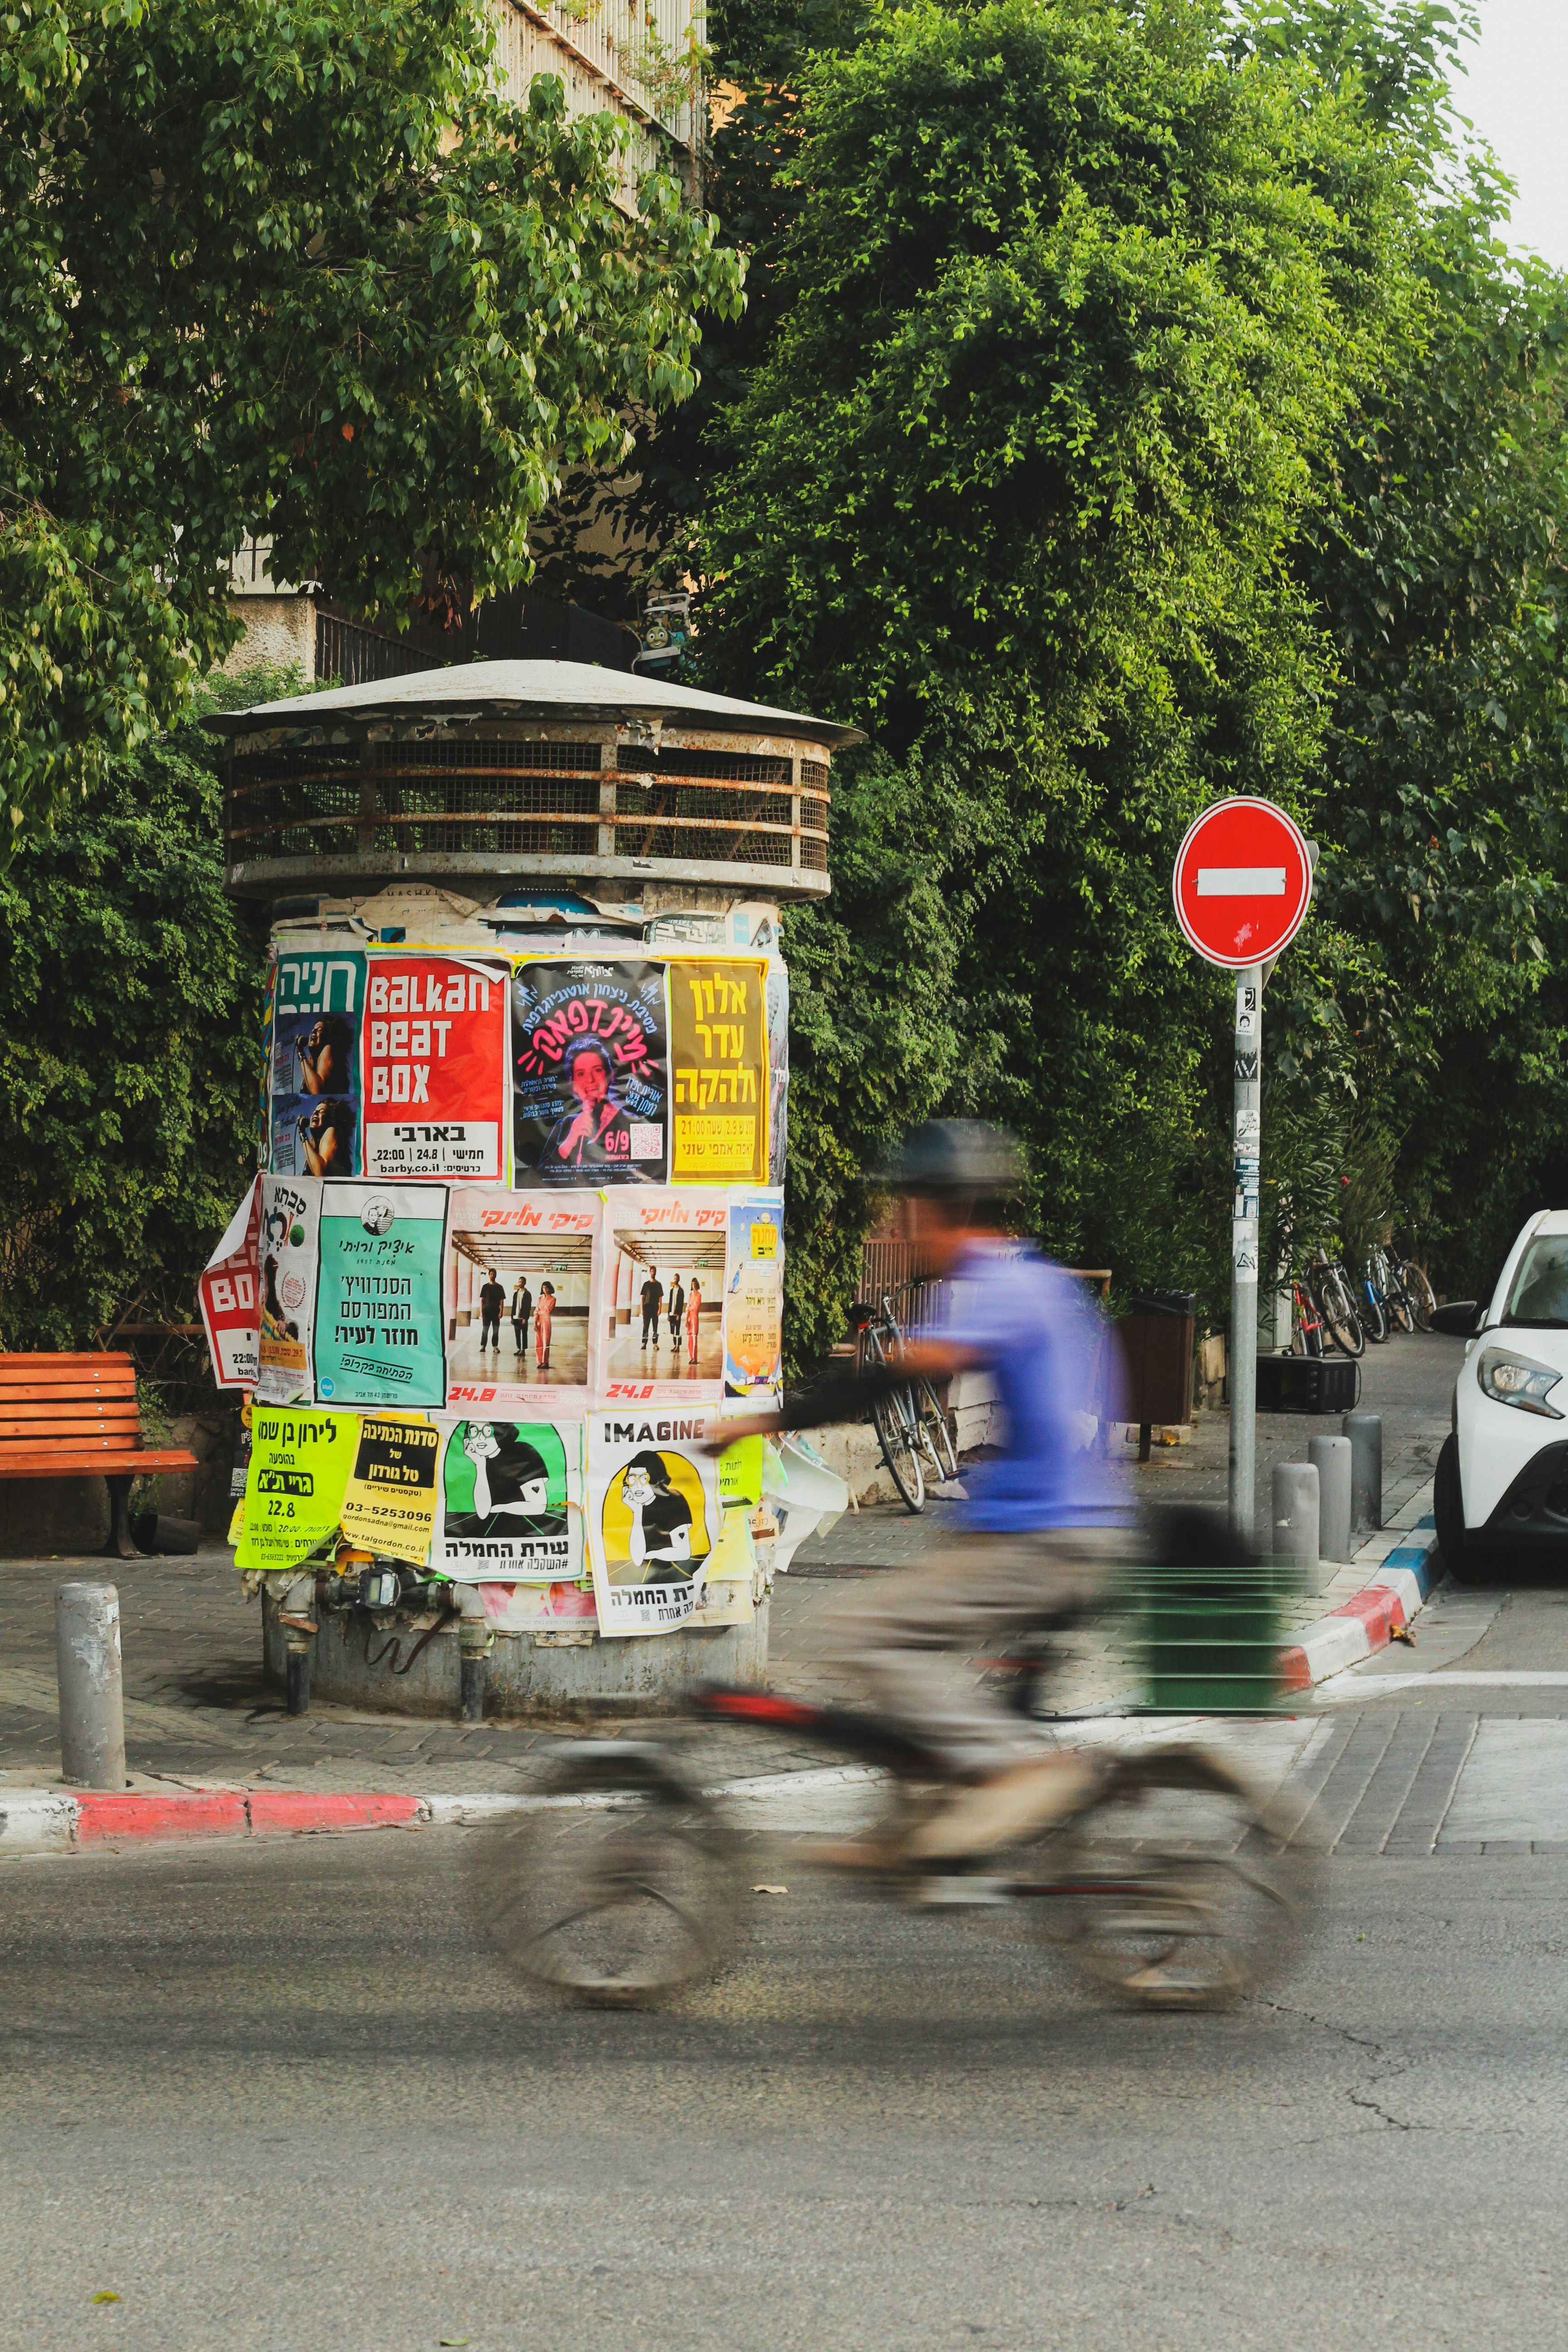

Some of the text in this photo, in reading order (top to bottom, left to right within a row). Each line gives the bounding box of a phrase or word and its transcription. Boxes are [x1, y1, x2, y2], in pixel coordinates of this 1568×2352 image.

[689, 972, 747, 1021] אלון
[695, 1024, 745, 1058] עדר
[370, 1063, 430, 1104] BOX
[675, 1062, 757, 1110] ולהקה
[394, 1126, 466, 1142] בארבי
[681, 1120, 705, 1135] 21:00
[707, 1120, 722, 1135] שעה
[604, 1130, 629, 1153] 6/9
[682, 1143, 705, 1155] שוני
[709, 1143, 733, 1155] אמפי
[377, 1149, 484, 1160] חמישי 24.8 22:00
[381, 1164, 439, 1174] barby.co.il
[480, 1203, 595, 1230] קיקי מלינקי
[640, 1200, 726, 1226] קיקי מלינקי
[752, 1228, 777, 1245] תחנה
[339, 1240, 415, 1258] איציק ורותי
[341, 1301, 411, 1320] המפורסם
[335, 1325, 419, 1346] חוזר לעיר!
[341, 1357, 413, 1380] הפתיחה בקרוב!
[448, 1387, 497, 1401] 24.8
[606, 1384, 654, 1398] 24.8
[282, 1422, 294, 1448] בן
[298, 1417, 337, 1449] לירון
[363, 1423, 438, 1448] סדנת הכתיבה
[604, 1418, 705, 1443] IMAGINE
[389, 1448, 402, 1459] של
[368, 1464, 419, 1482] טל גורדון
[289, 1475, 312, 1493] גריי
[268, 1499, 295, 1518] 22.8
[346, 1502, 432, 1522] 03-5253096
[279, 1524, 300, 1533] 20:00
[343, 1514, 430, 1533] gordonsadna@gmail.com
[446, 1541, 568, 1558] שרת החמלה
[500, 1558, 568, 1571] #השקפה אחרת
[611, 1589, 667, 1606] החמלה
[658, 1606, 682, 1621] אחרת
